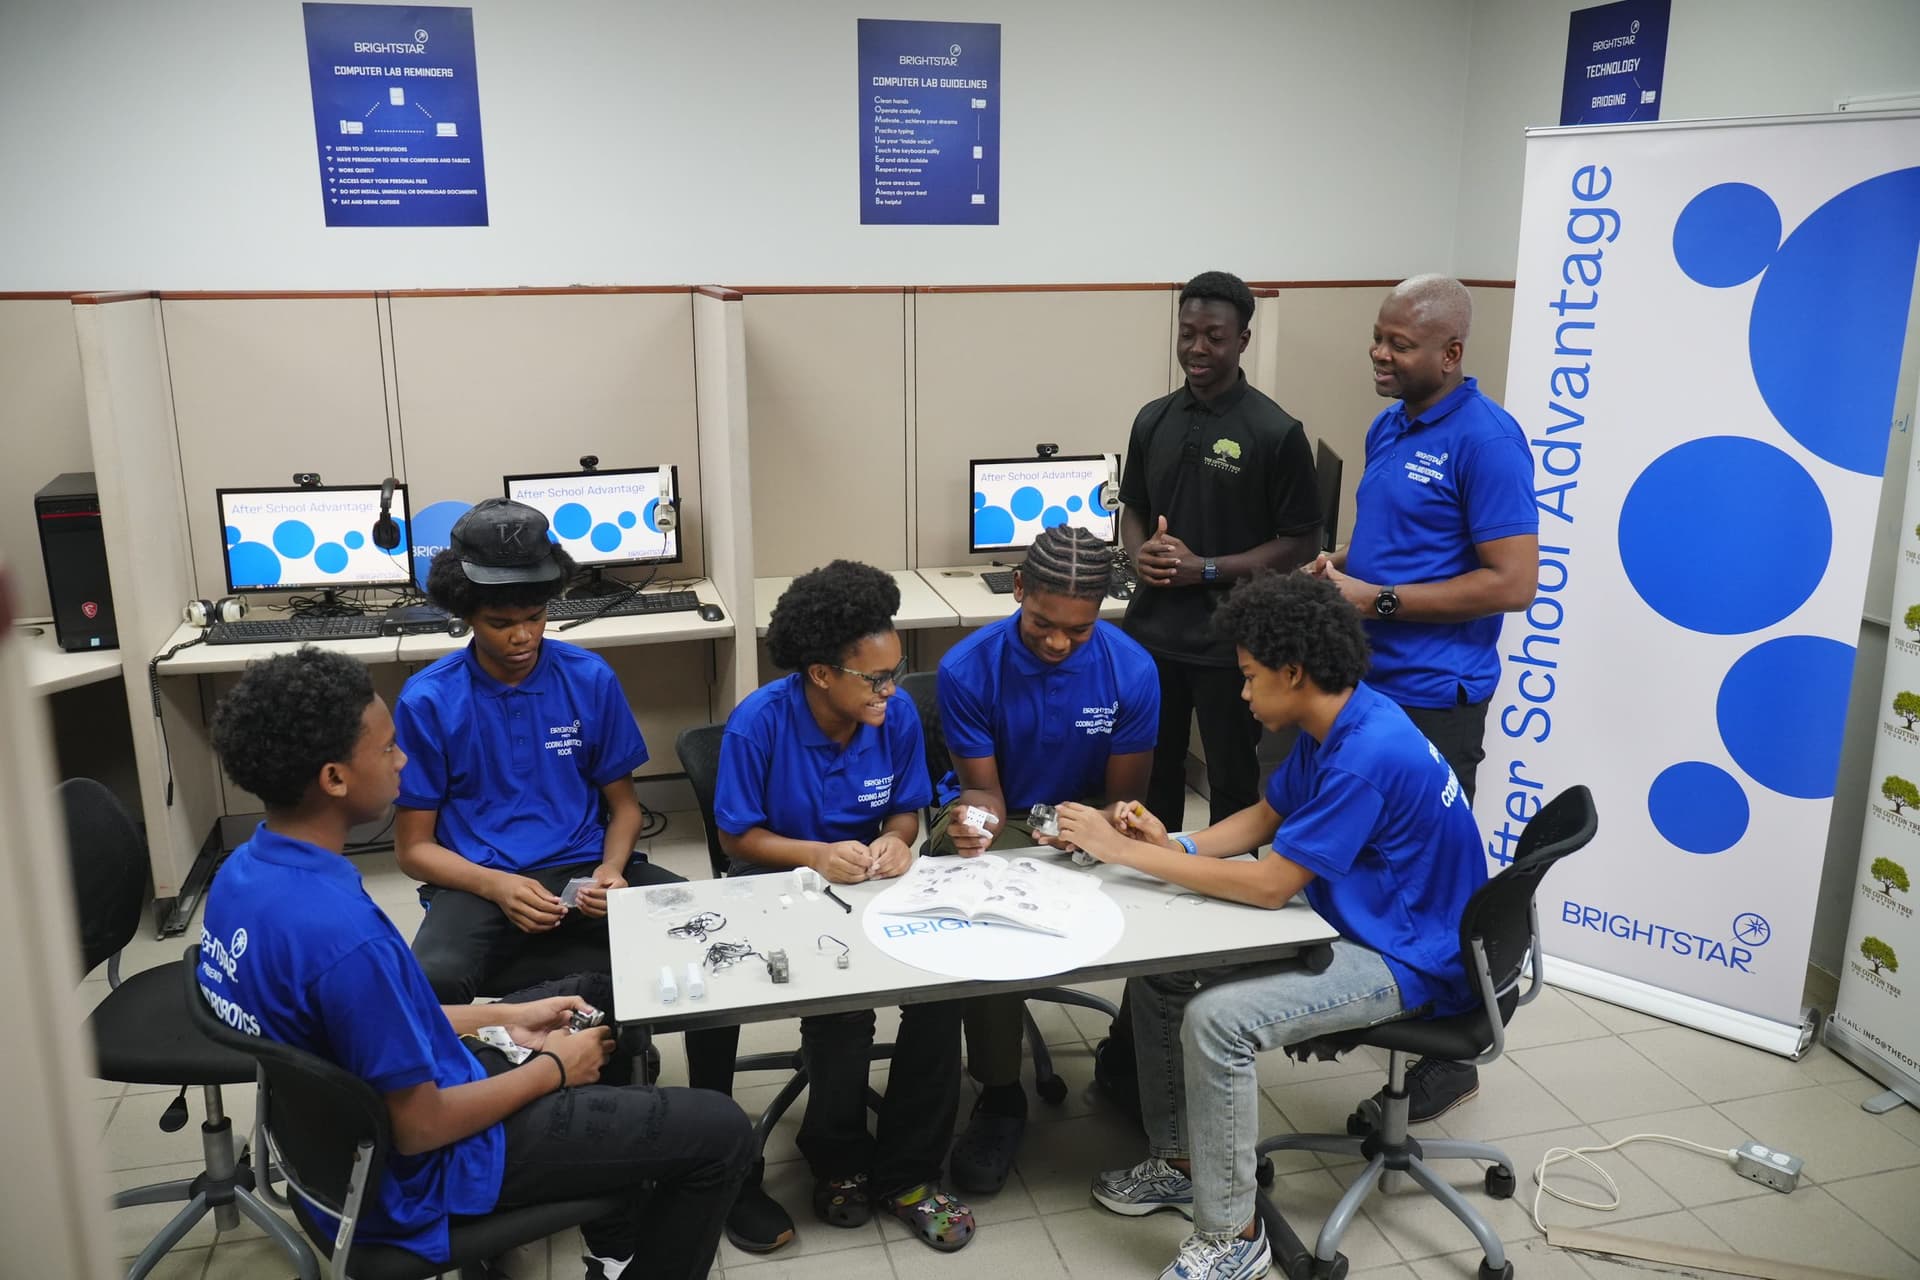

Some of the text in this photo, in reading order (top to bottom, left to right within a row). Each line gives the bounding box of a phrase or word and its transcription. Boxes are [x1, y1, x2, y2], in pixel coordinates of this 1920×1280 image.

[354, 42, 426, 54] BRIGHTSTAR
[1592, 35, 1636, 52] BRIGHTSTAR
[899, 56, 958, 66] BRIGHTSTAR
[1586, 57, 1641, 79] TECHNOLOGY
[334, 66, 454, 77] COMPUTER LAB REMINDERS
[873, 77, 988, 89] COMPUTER LAB GUIDELINES
[874, 96, 892, 104] Clean
[1591, 93, 1627, 109] BRIDGING
[874, 105, 898, 114] Operate
[875, 126, 897, 134] Practice
[875, 164, 897, 173] Respect
[1530, 165, 1622, 524] Advantage
[981, 471, 1093, 482] After School Advantage
[517, 483, 646, 500] After School Advantage
[231, 502, 375, 514] After School Advantage
[1501, 545, 1571, 743] School
[1894, 727, 1919, 741] COTTON
[1883, 809, 1907, 825] COTTON
[1872, 890, 1896, 907] COTTON
[1898, 903, 1913, 917] TREE
[1562, 901, 1753, 974] BRIGHTSTAR
[1862, 968, 1886, 986] COTTON
[1887, 982, 1901, 996] TREE
